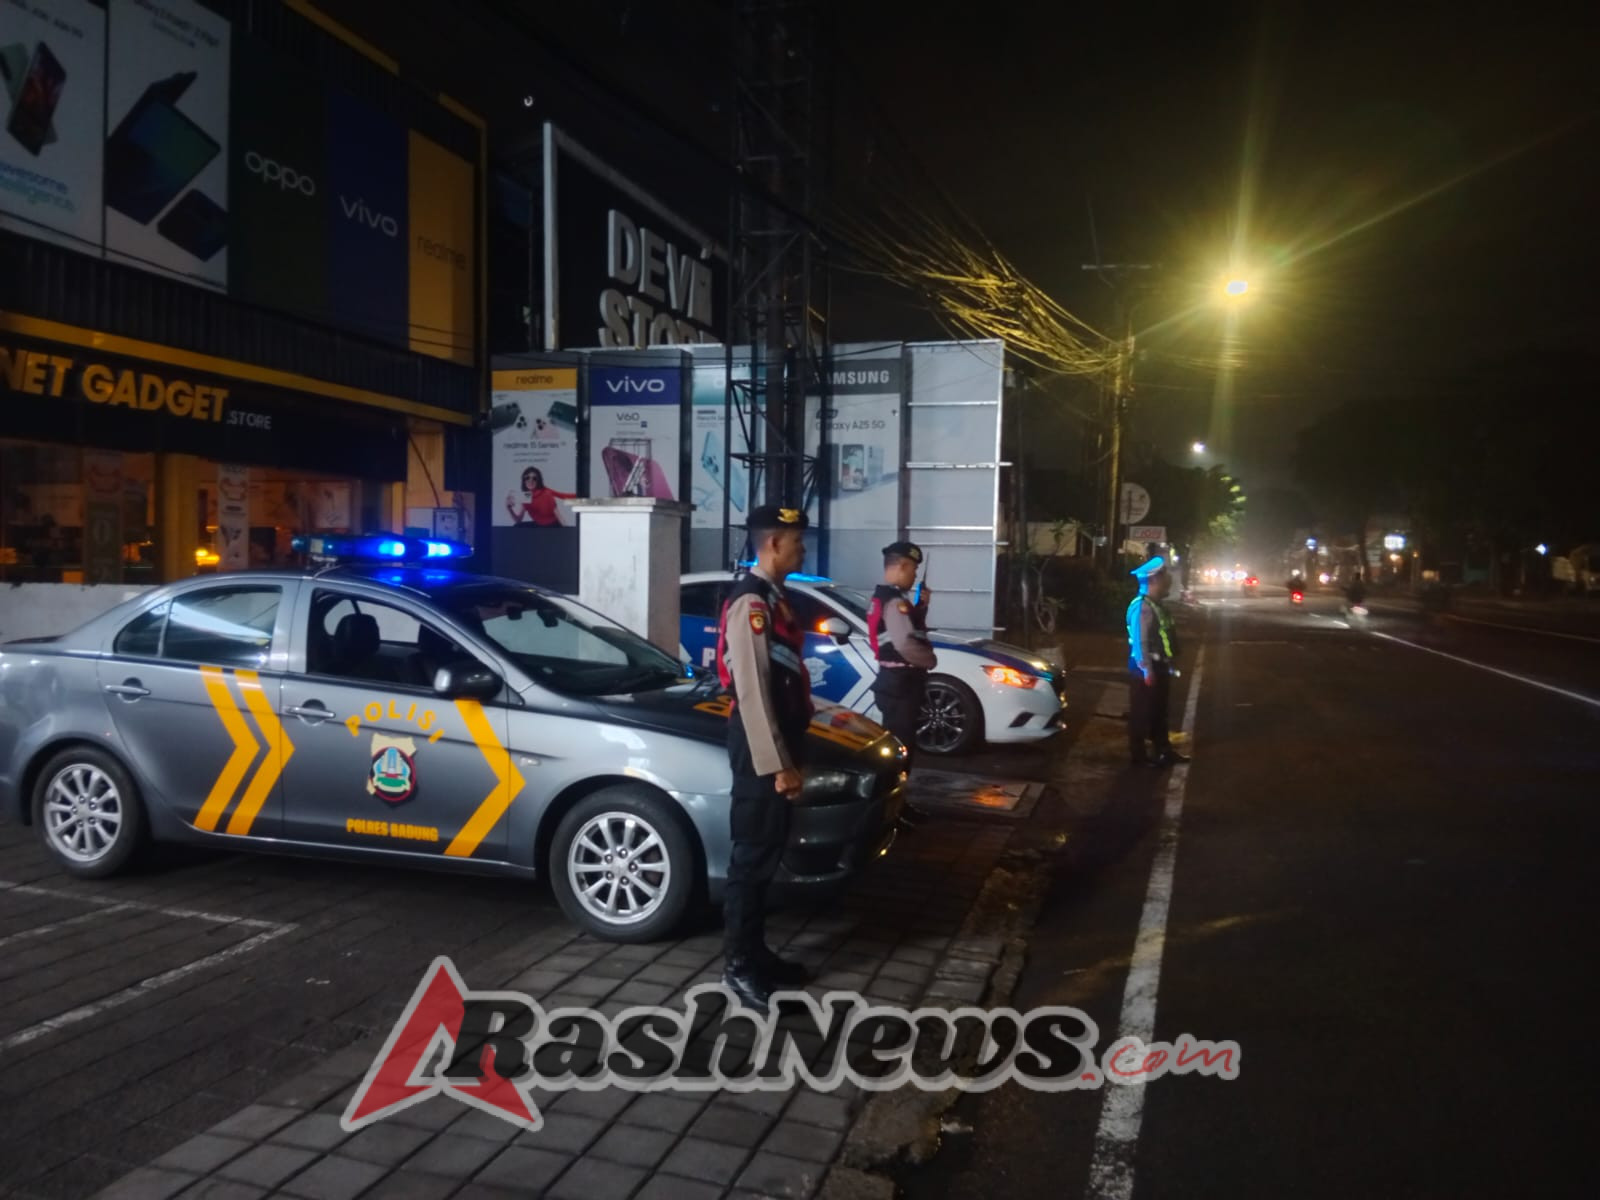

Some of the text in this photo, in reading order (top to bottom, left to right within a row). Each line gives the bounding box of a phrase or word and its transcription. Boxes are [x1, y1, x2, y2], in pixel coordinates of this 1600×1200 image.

[245, 151, 316, 197] oppo
[340, 195, 399, 238] vivo
[417, 235, 467, 272] realme
[82, 364, 230, 423] GADGET
[515, 375, 554, 385] realme
[606, 375, 666, 393] vivo
[616, 412, 641, 421] V60
[872, 420, 886, 430] 5G
[345, 700, 445, 744] POLISI
[346, 818, 388, 837] POLRES
